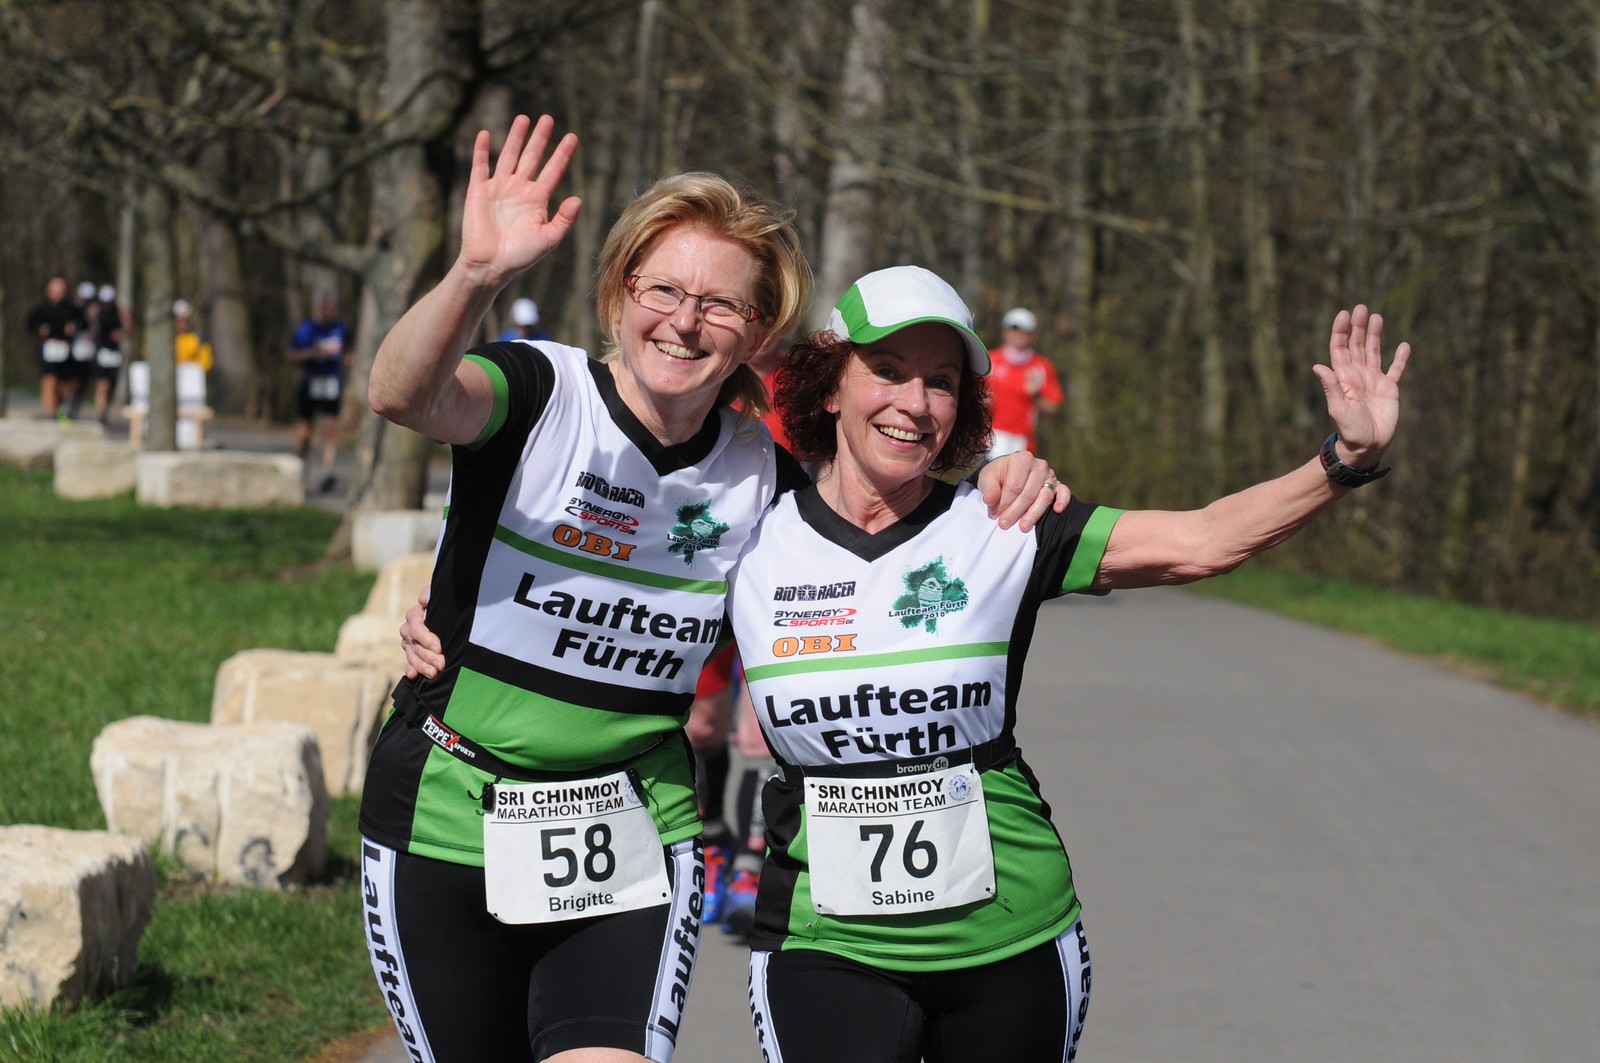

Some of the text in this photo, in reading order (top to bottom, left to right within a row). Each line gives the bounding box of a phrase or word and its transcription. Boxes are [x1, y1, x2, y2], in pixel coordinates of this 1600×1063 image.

[552, 524, 637, 561] OBI
[513, 572, 723, 644] Laufteam
[889, 600, 967, 617] Laufteam Fürth
[925, 611, 945, 619] 2010
[552, 628, 684, 680] Fürth
[772, 634, 857, 657] OBI
[765, 681, 992, 728] Laufteam
[453, 743, 476, 758] SPORTS
[821, 721, 956, 758] Fürth
[498, 791, 524, 805] SRI
[532, 780, 620, 804] CHINMOY
[818, 785, 846, 799] SRI
[851, 778, 944, 800] CHINMOY
[497, 796, 624, 819] MARATHON TEAM
[818, 794, 946, 814] MARATHON TEAM
[540, 823, 615, 888] 58
[859, 820, 938, 882] 76
[549, 892, 614, 912] Brigitte
[872, 890, 935, 906] Sabine
